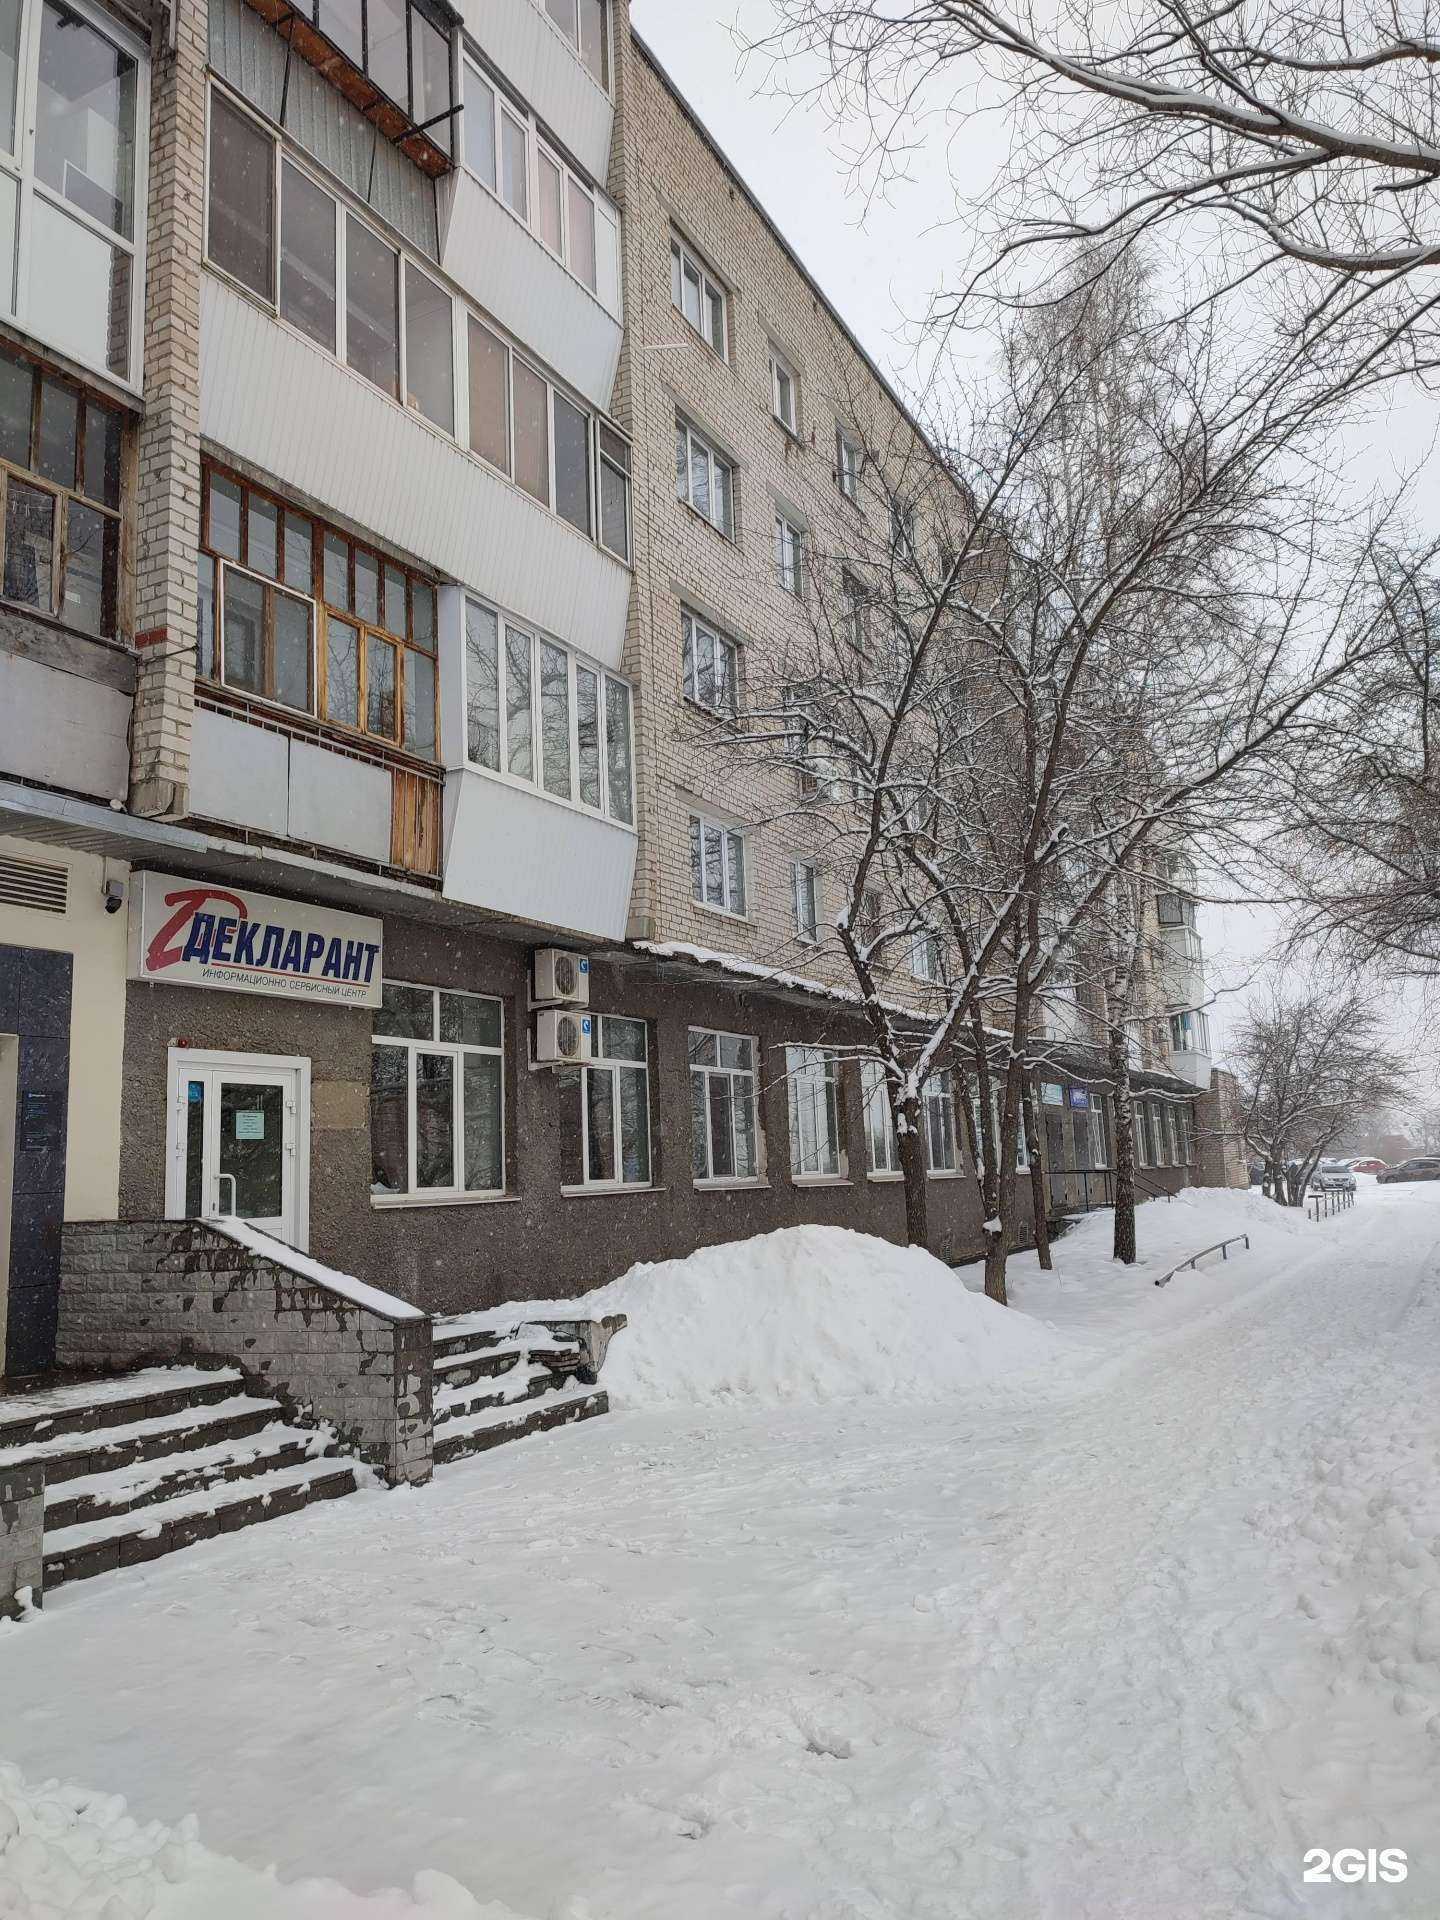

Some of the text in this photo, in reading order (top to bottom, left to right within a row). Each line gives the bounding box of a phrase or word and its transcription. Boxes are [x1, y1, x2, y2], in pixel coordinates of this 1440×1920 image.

[182, 911, 380, 982] ДЕКЛАРАНТ
[201, 967, 287, 988] ИНФОРМАЦИОННО
[341, 986, 367, 999] ЦЕНТР
